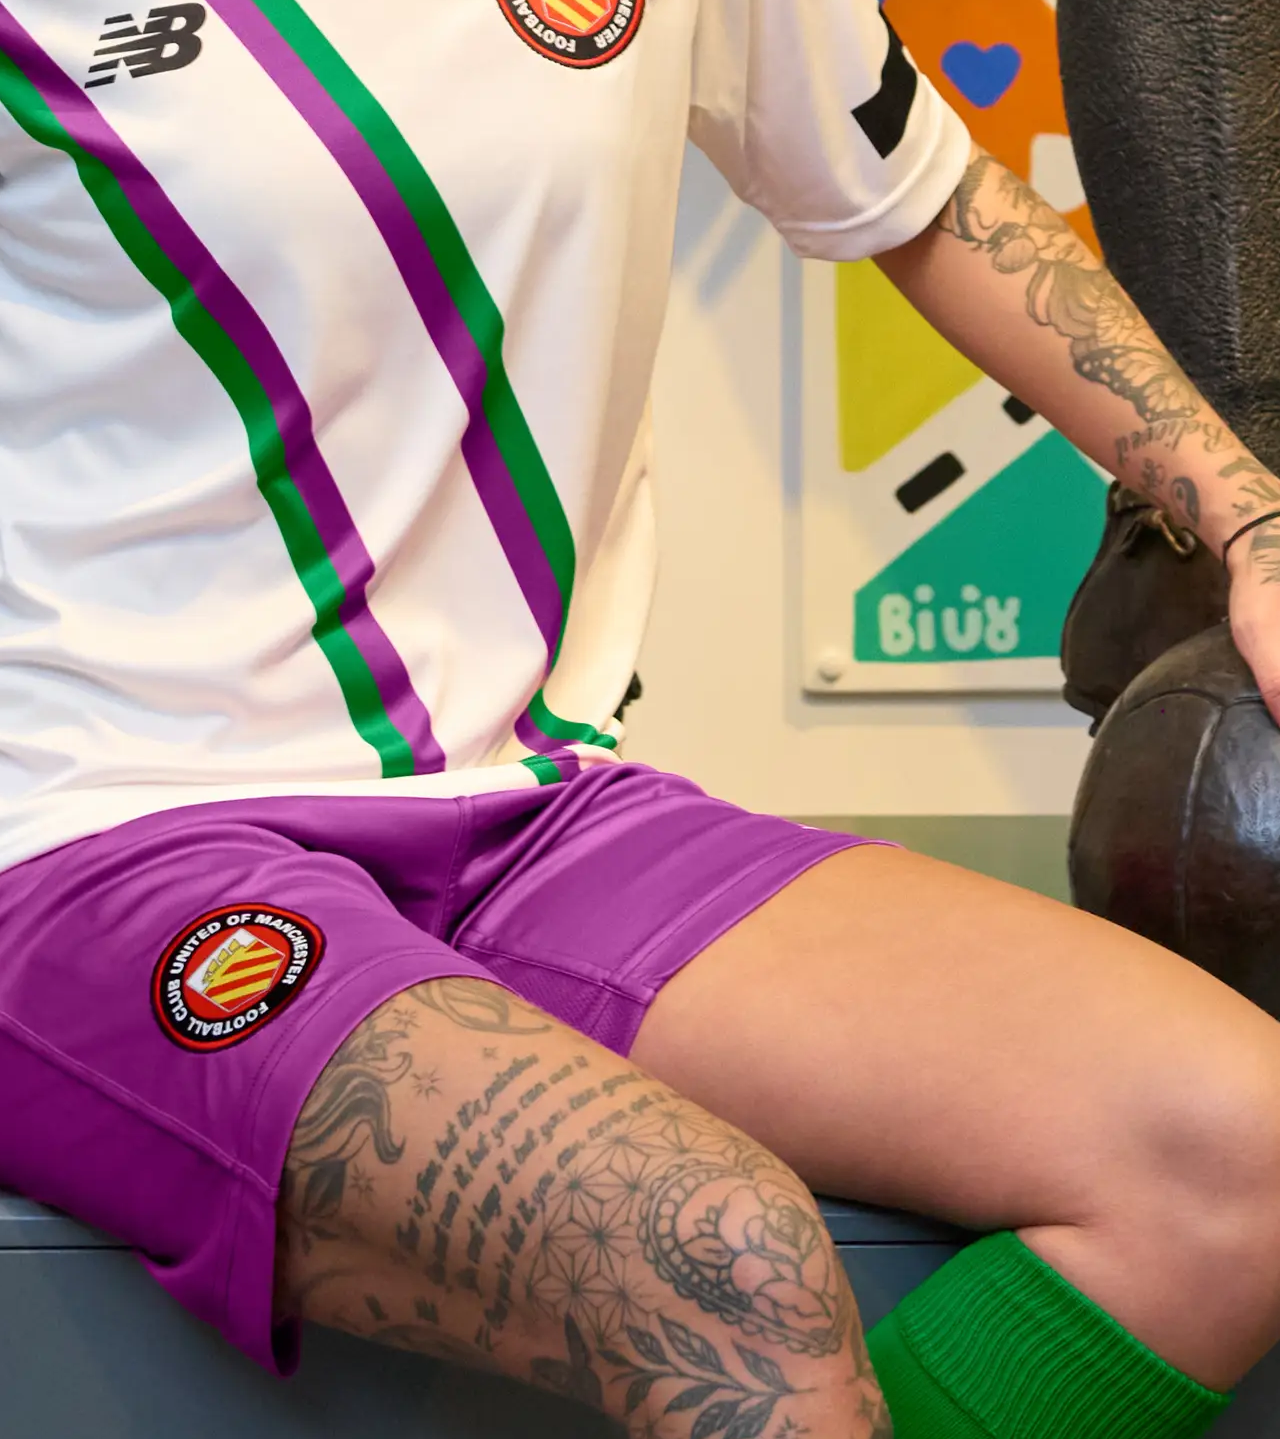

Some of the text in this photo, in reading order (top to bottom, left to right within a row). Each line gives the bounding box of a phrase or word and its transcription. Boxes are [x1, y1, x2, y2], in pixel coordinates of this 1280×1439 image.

[167, 913, 310, 1037] FOOTBALL CLUB UNITED OF MANCHESTER
